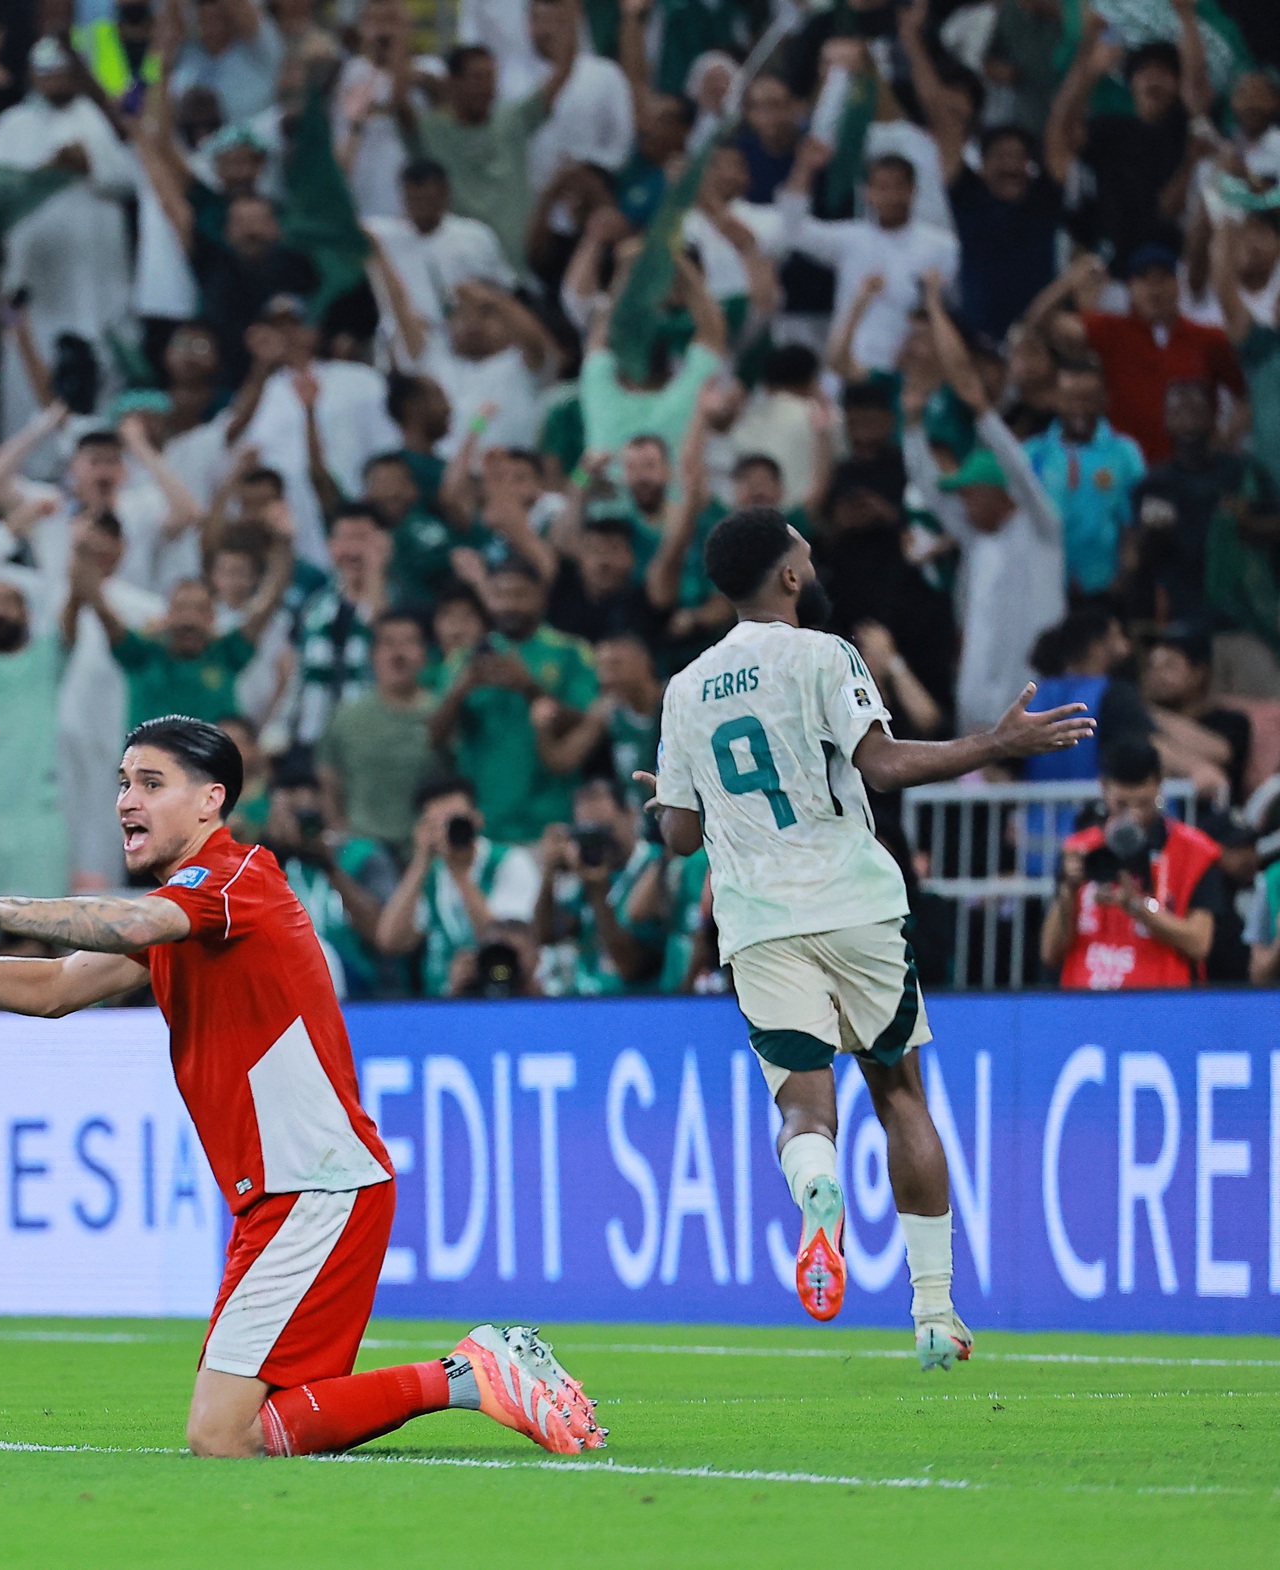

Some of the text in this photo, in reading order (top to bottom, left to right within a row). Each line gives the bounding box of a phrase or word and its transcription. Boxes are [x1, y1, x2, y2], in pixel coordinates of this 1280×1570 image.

[702, 665, 760, 702] FERAS
[711, 715, 797, 830] 9
[1042, 1043, 1280, 1300] CRE
